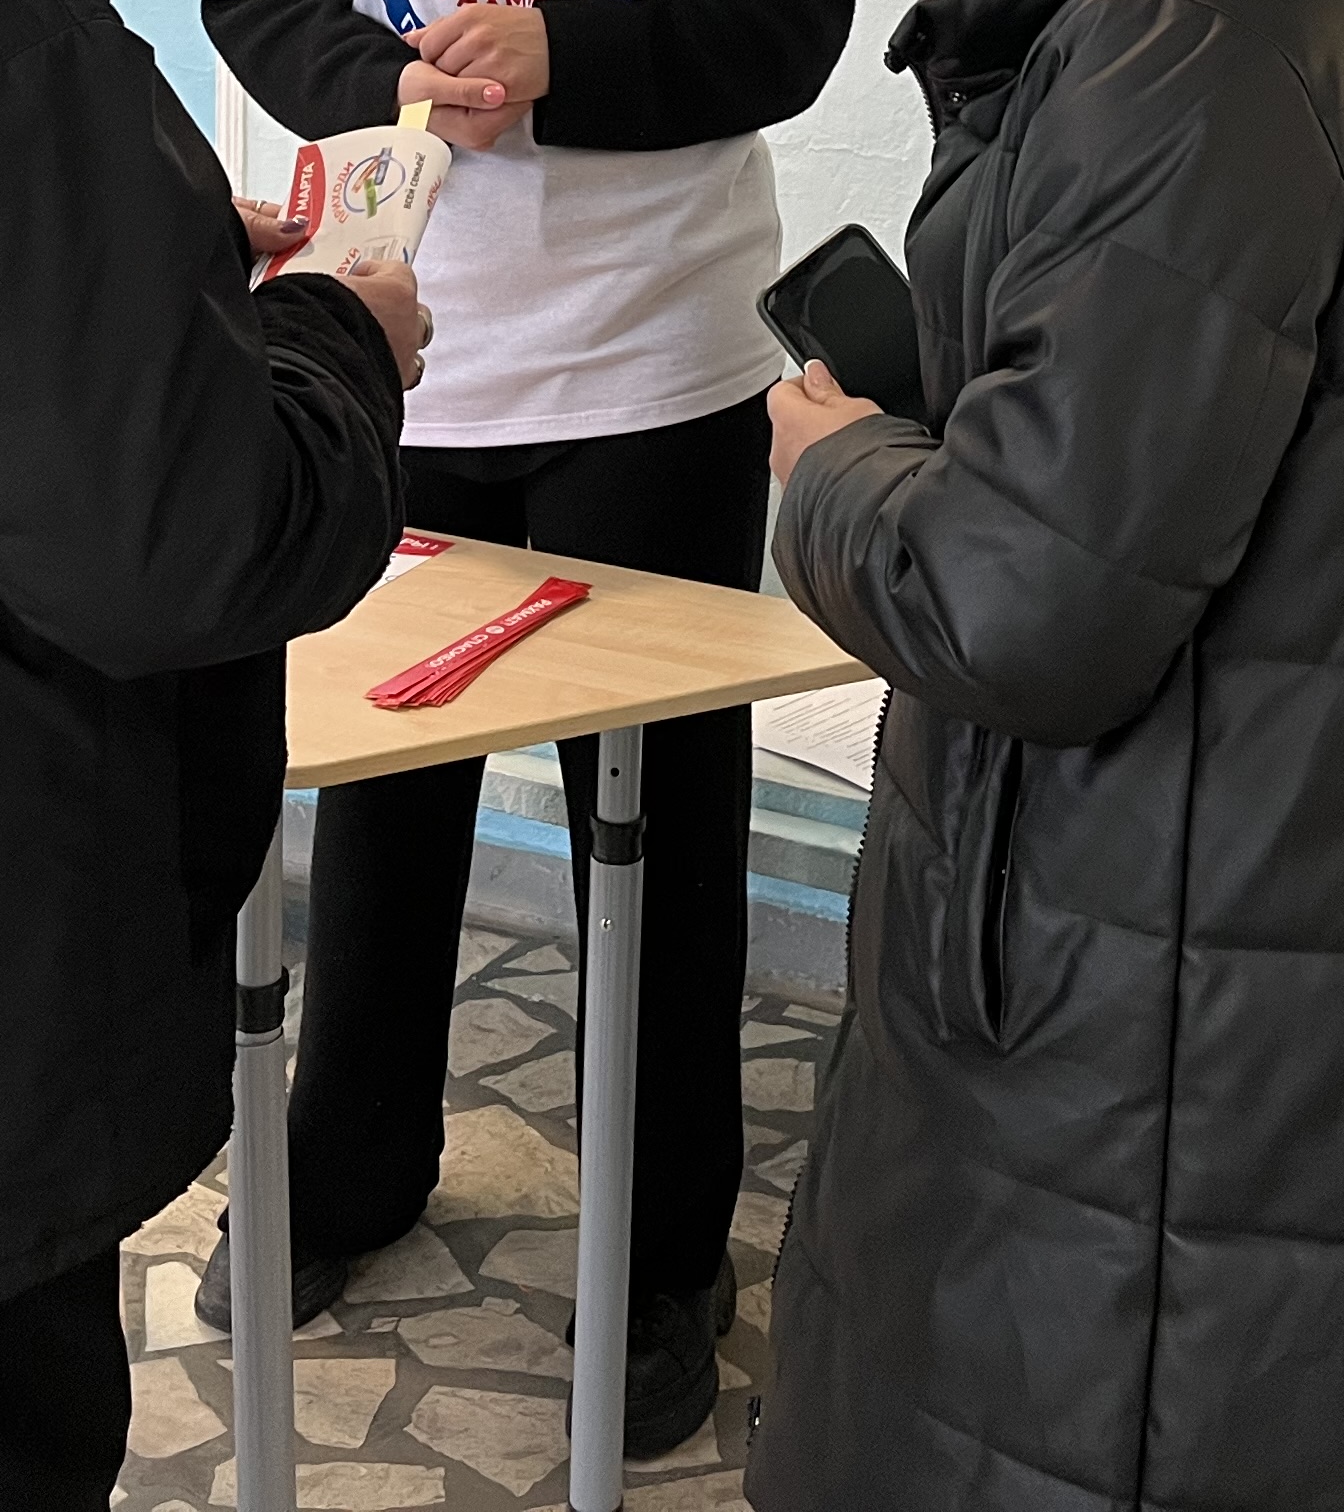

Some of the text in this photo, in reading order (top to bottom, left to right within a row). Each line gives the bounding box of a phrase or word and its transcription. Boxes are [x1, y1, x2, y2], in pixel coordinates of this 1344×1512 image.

[296, 161, 315, 210] МАРТА
[331, 161, 354, 224] ПРИХОДИ
[336, 247, 361, 276] ВУЙ
